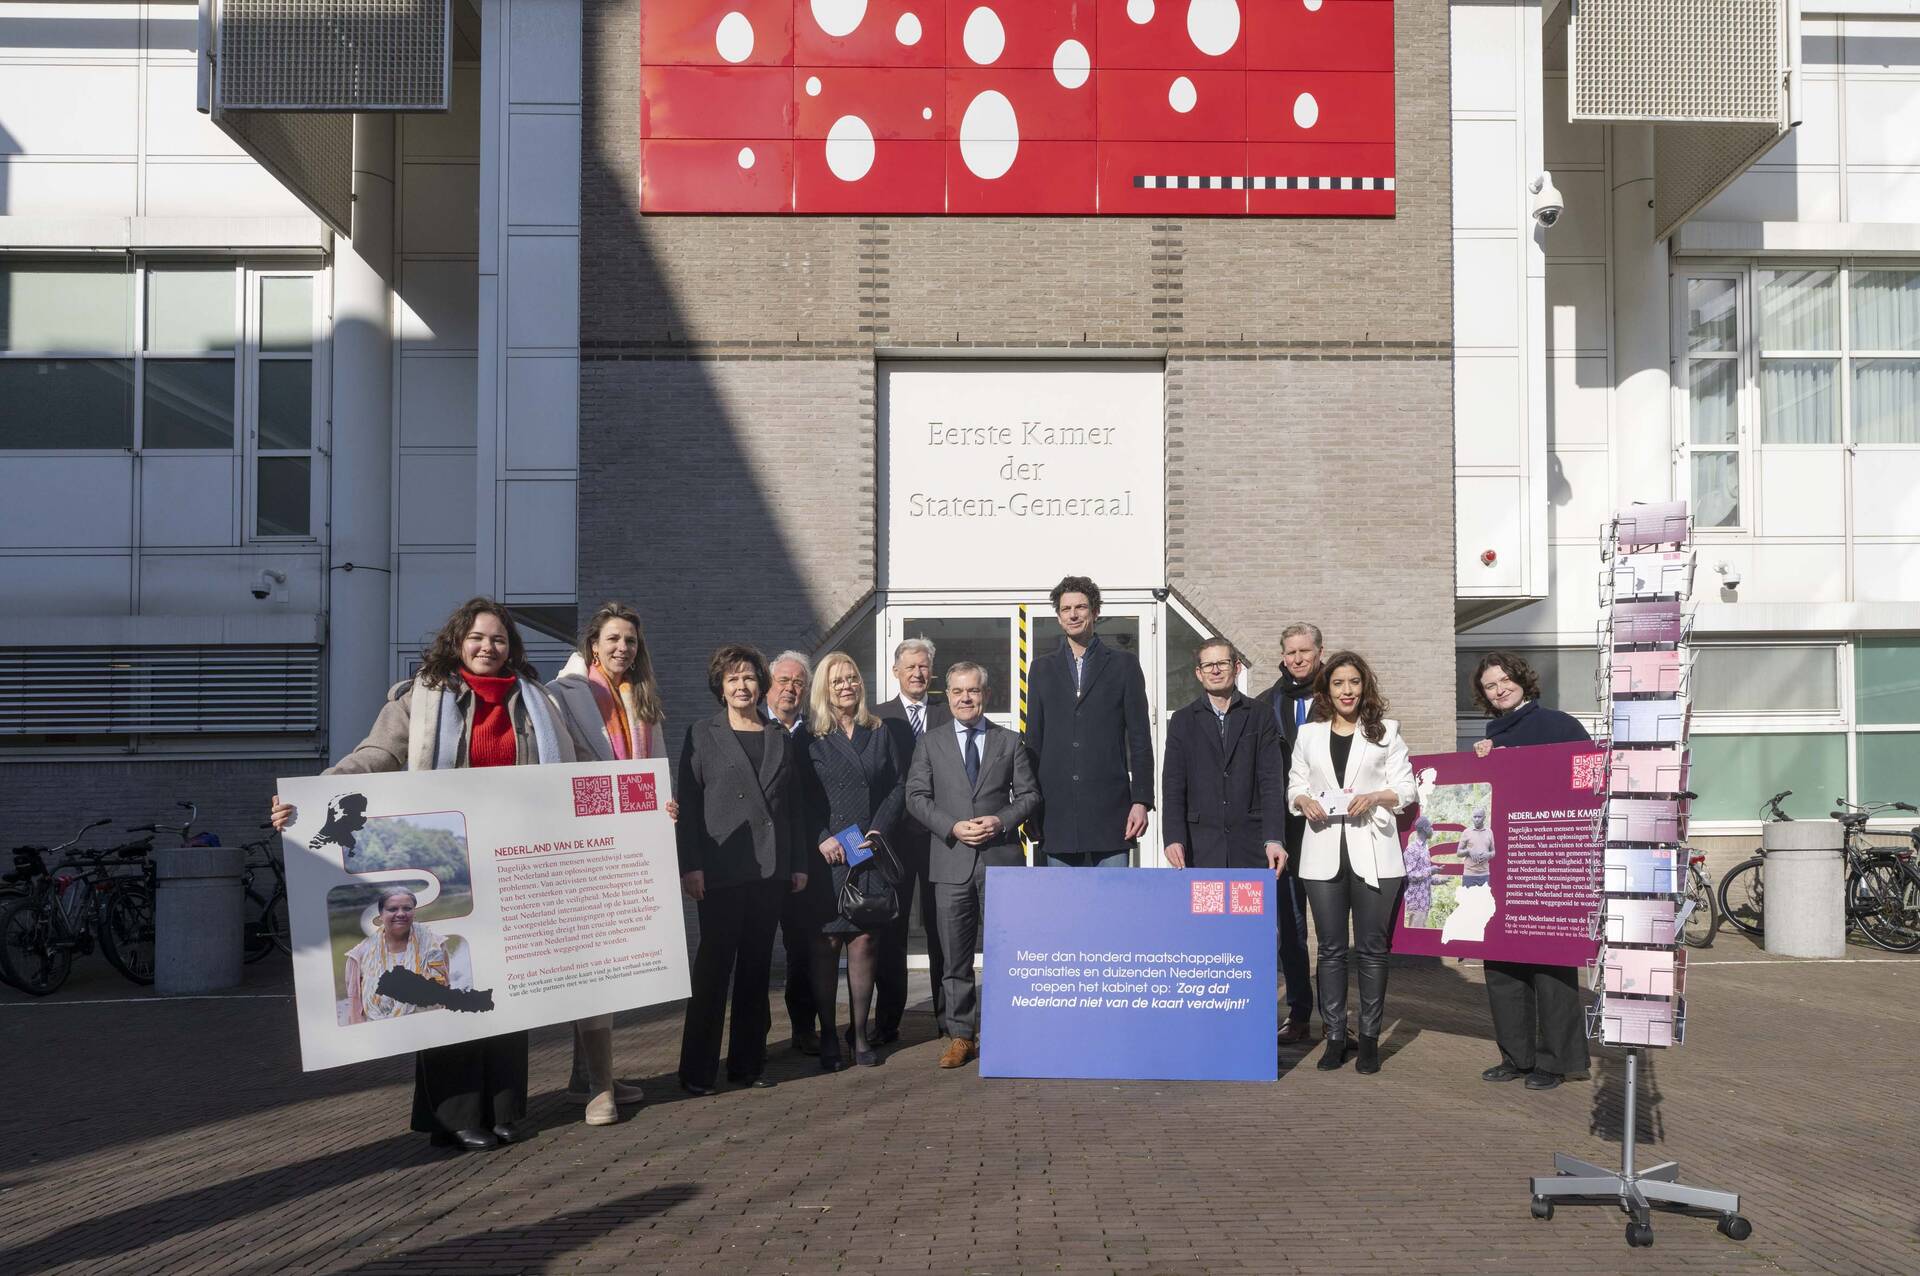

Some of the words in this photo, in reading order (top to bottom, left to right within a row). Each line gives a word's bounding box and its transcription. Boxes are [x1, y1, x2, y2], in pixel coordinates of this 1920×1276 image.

[928, 422, 1012, 446] Eerste
[1021, 421, 1115, 445] Kamer
[999, 456, 1044, 480] der
[909, 491, 1134, 517] Staten-Generaal
[630, 801, 655, 810] KAART
[495, 841, 551, 857] NEDERLAND
[554, 840, 572, 851] VAN
[574, 839, 585, 849] DE
[587, 837, 614, 848] KAART
[497, 864, 531, 873] Dagelijks
[586, 854, 622, 863] wereldwijd
[513, 871, 549, 881] Nederland
[564, 867, 603, 876] oplossingen
[621, 860, 650, 869] mondiale
[499, 884, 538, 894] problemen.
[555, 877, 587, 886] activisten
[599, 872, 639, 880] ondernemers
[527, 889, 563, 899] versterken
[578, 882, 632, 894] gemeenschappen
[500, 903, 540, 912] bevorderen
[502, 913, 518, 921] staat
[520, 908, 556, 919] Nederland
[557, 902, 602, 914] internationaal
[513, 918, 556, 930] voorgestelde
[557, 913, 604, 924] bezuinigingen
[614, 906, 660, 916] ontwikkelings-
[504, 929, 554, 941] samenwerking
[555, 925, 575, 934] dreigt
[590, 920, 616, 929] cruciale
[504, 942, 528, 953] positie
[544, 934, 579, 945] Nederland
[607, 926, 646, 936] onbezonnen
[506, 948, 551, 962] pennenstreek
[552, 942, 593, 954] weggegooid
[602, 938, 628, 946] worden.
[1017, 950, 1048, 963] Meer
[1052, 951, 1075, 963] dan
[1080, 951, 1131, 963] honderd
[1135, 952, 1243, 966] maatschappelijke
[539, 964, 574, 975] Nederland
[612, 955, 629, 963] kaart
[1009, 966, 1080, 979] organisaties
[1084, 968, 1099, 978] en
[1103, 967, 1166, 979] duizenden
[1170, 968, 1251, 979] Nederlanders
[1032, 984, 1075, 996] roepen
[1078, 982, 1098, 993] het
[1103, 982, 1148, 994] kabinet
[1152, 984, 1171, 996] op:
[1208, 983, 1229, 994] dat
[1012, 996, 1077, 1008] Nederland
[1080, 997, 1102, 1008] niet
[1106, 1000, 1128, 1008] van
[1132, 997, 1148, 1008] de
[1152, 997, 1183, 1009] kaart
